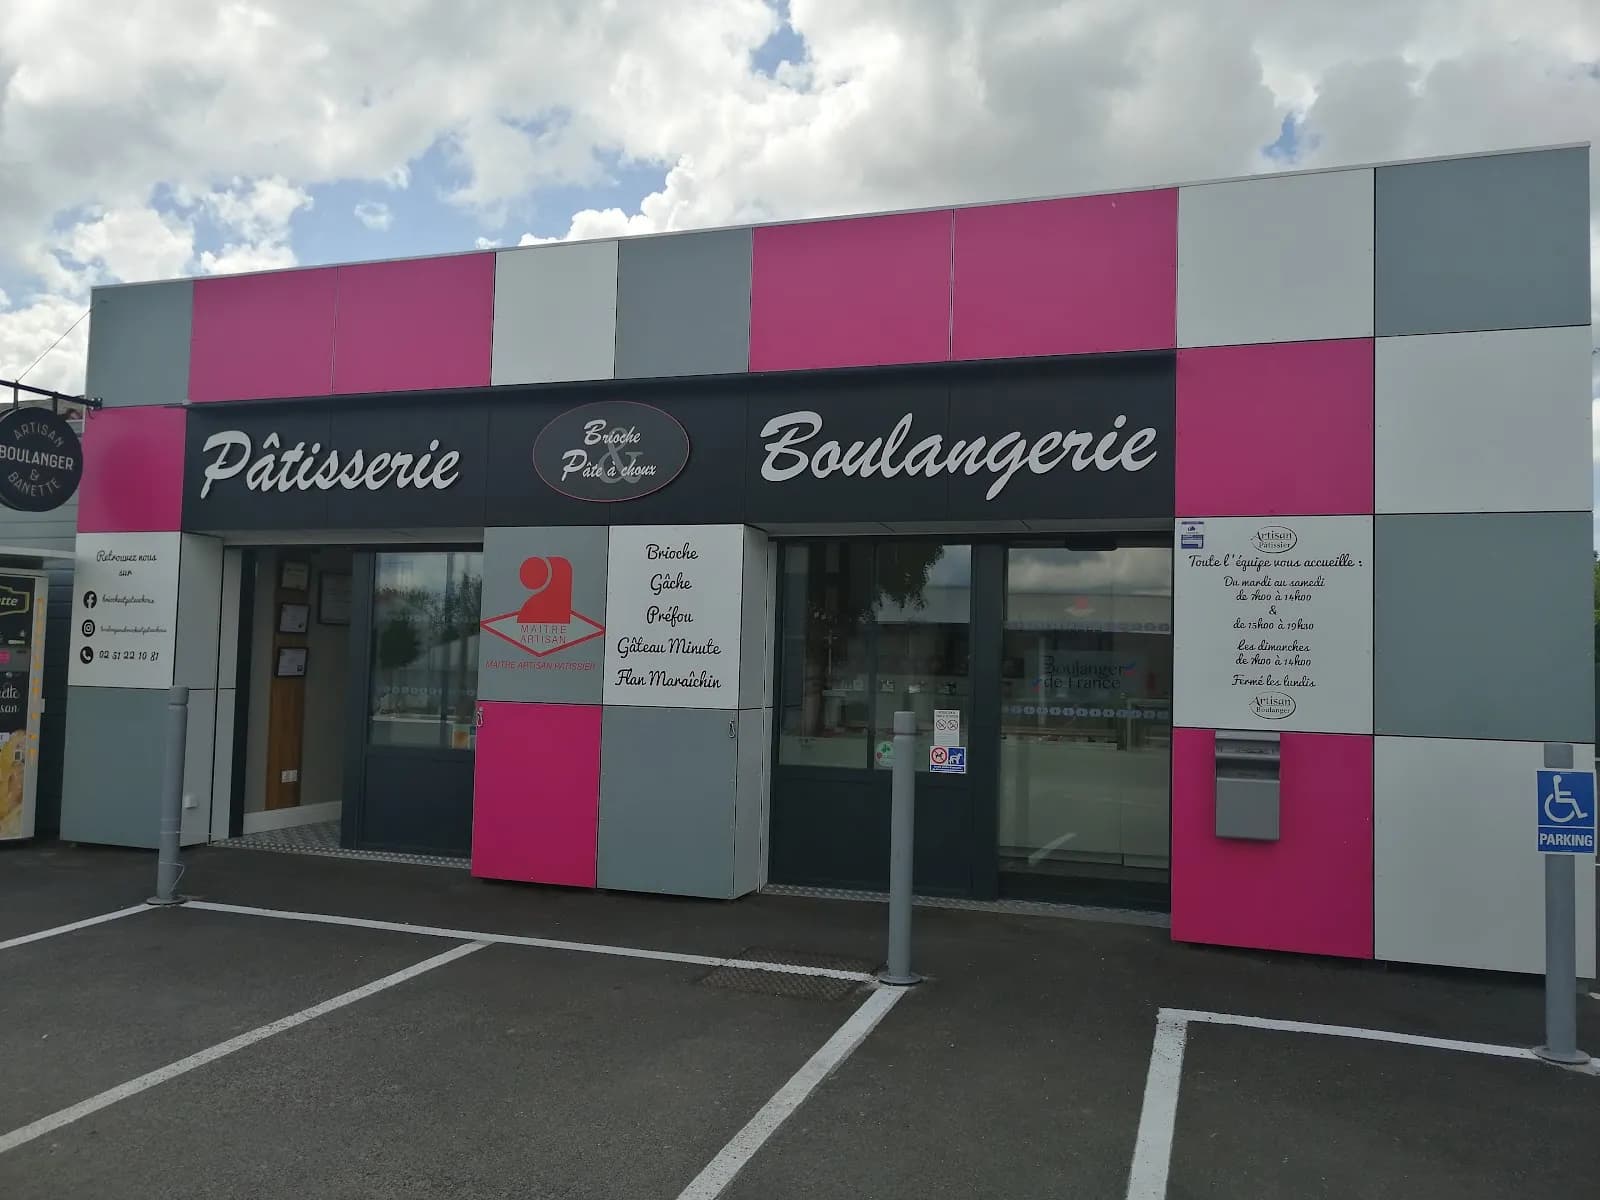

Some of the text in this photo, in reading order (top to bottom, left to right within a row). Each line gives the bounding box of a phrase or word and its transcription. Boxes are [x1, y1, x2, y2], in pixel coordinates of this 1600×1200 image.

[13, 421, 65, 448] ARTISAN
[583, 419, 641, 446] Brioche
[0, 444, 74, 471] BOULANGER
[759, 410, 1157, 501] Boulangerie
[201, 430, 461, 500] Pâtisserie
[561, 449, 657, 482] Pâte à choux
[30, 468, 40, 481] &
[8, 471, 61, 497] BANETTE
[1250, 530, 1292, 542] Artisan
[96, 550, 138, 562] Retrouvez
[646, 542, 699, 560] Brioche
[1189, 554, 1222, 567] Toute
[1303, 553, 1356, 567] accueille
[650, 572, 692, 595] Gâche
[1223, 575, 1326, 587] Du mardi au samedi
[1236, 589, 1312, 601] de 7h00 à 14h00
[647, 606, 694, 627] Préfou
[1268, 605, 1277, 615] &
[521, 625, 567, 634] MAITRE
[1233, 617, 1246, 629] de
[1248, 617, 1275, 629] 15h00
[1277, 618, 1285, 630] à
[520, 635, 566, 644] ARTISAN
[1257, 639, 1311, 651] dimanches
[617, 637, 721, 658] Gâteau Minute
[99, 650, 109, 659] 02
[123, 650, 135, 659] 22
[1235, 653, 1248, 664] de
[1275, 654, 1282, 665] à
[1284, 654, 1312, 666] 14h00
[518, 661, 553, 671] ARTISAN
[1043, 655, 1123, 680] Boulanger
[615, 669, 722, 689] Flan Maraîchin
[1043, 674, 1121, 690] de France
[1232, 674, 1317, 687] Fermé les lundis
[1249, 695, 1292, 707] Artisan
[1256, 706, 1290, 714] Boulanger
[1539, 833, 1593, 847] PARKING
